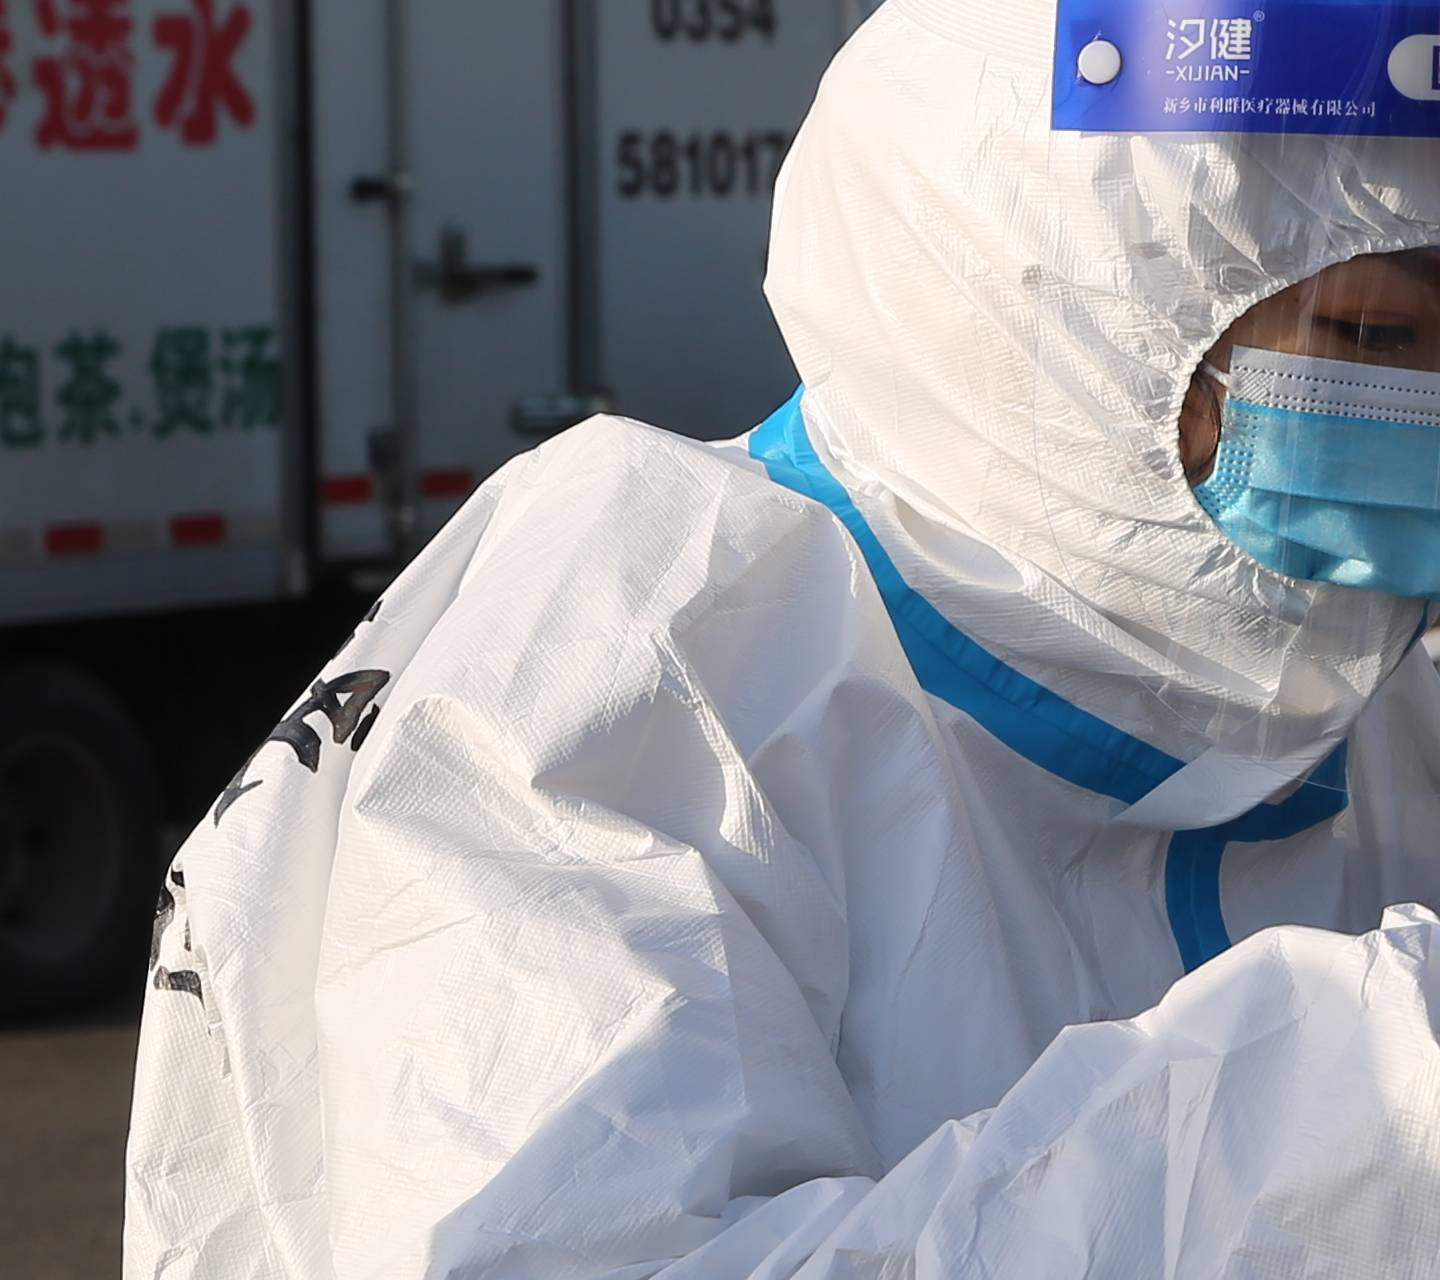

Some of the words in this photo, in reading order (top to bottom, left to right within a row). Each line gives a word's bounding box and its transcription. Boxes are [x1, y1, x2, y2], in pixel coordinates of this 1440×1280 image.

[1163, 96, 1377, 118] 新乡市利群医疗器械有限公司
